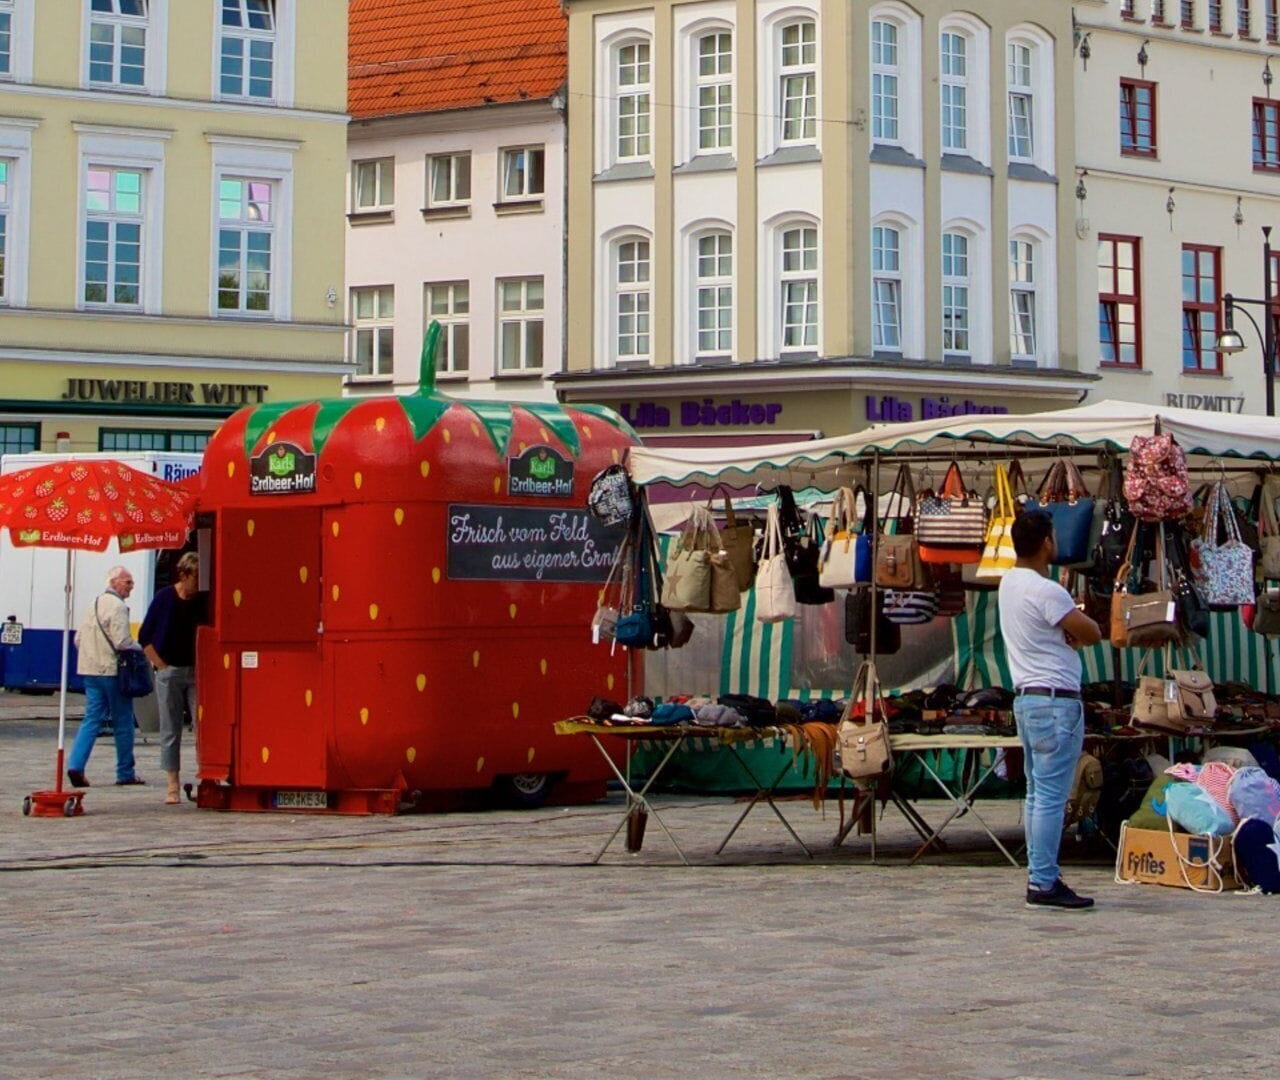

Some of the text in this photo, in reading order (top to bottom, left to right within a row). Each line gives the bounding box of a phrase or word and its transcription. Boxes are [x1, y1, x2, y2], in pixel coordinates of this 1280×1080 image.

[62, 378, 269, 405] JUWELIER WITT
[621, 398, 782, 428] Lila Bäcker
[866, 395, 912, 423] Lila
[252, 473, 314, 491] Erdbeer-Hof
[512, 477, 572, 494] Erdbeer-Hof
[42, 531, 103, 546] Erdbeer-Hof
[451, 512, 589, 543] Frisch vom Feld
[492, 553, 520, 570] aus
[523, 549, 580, 580] eigener
